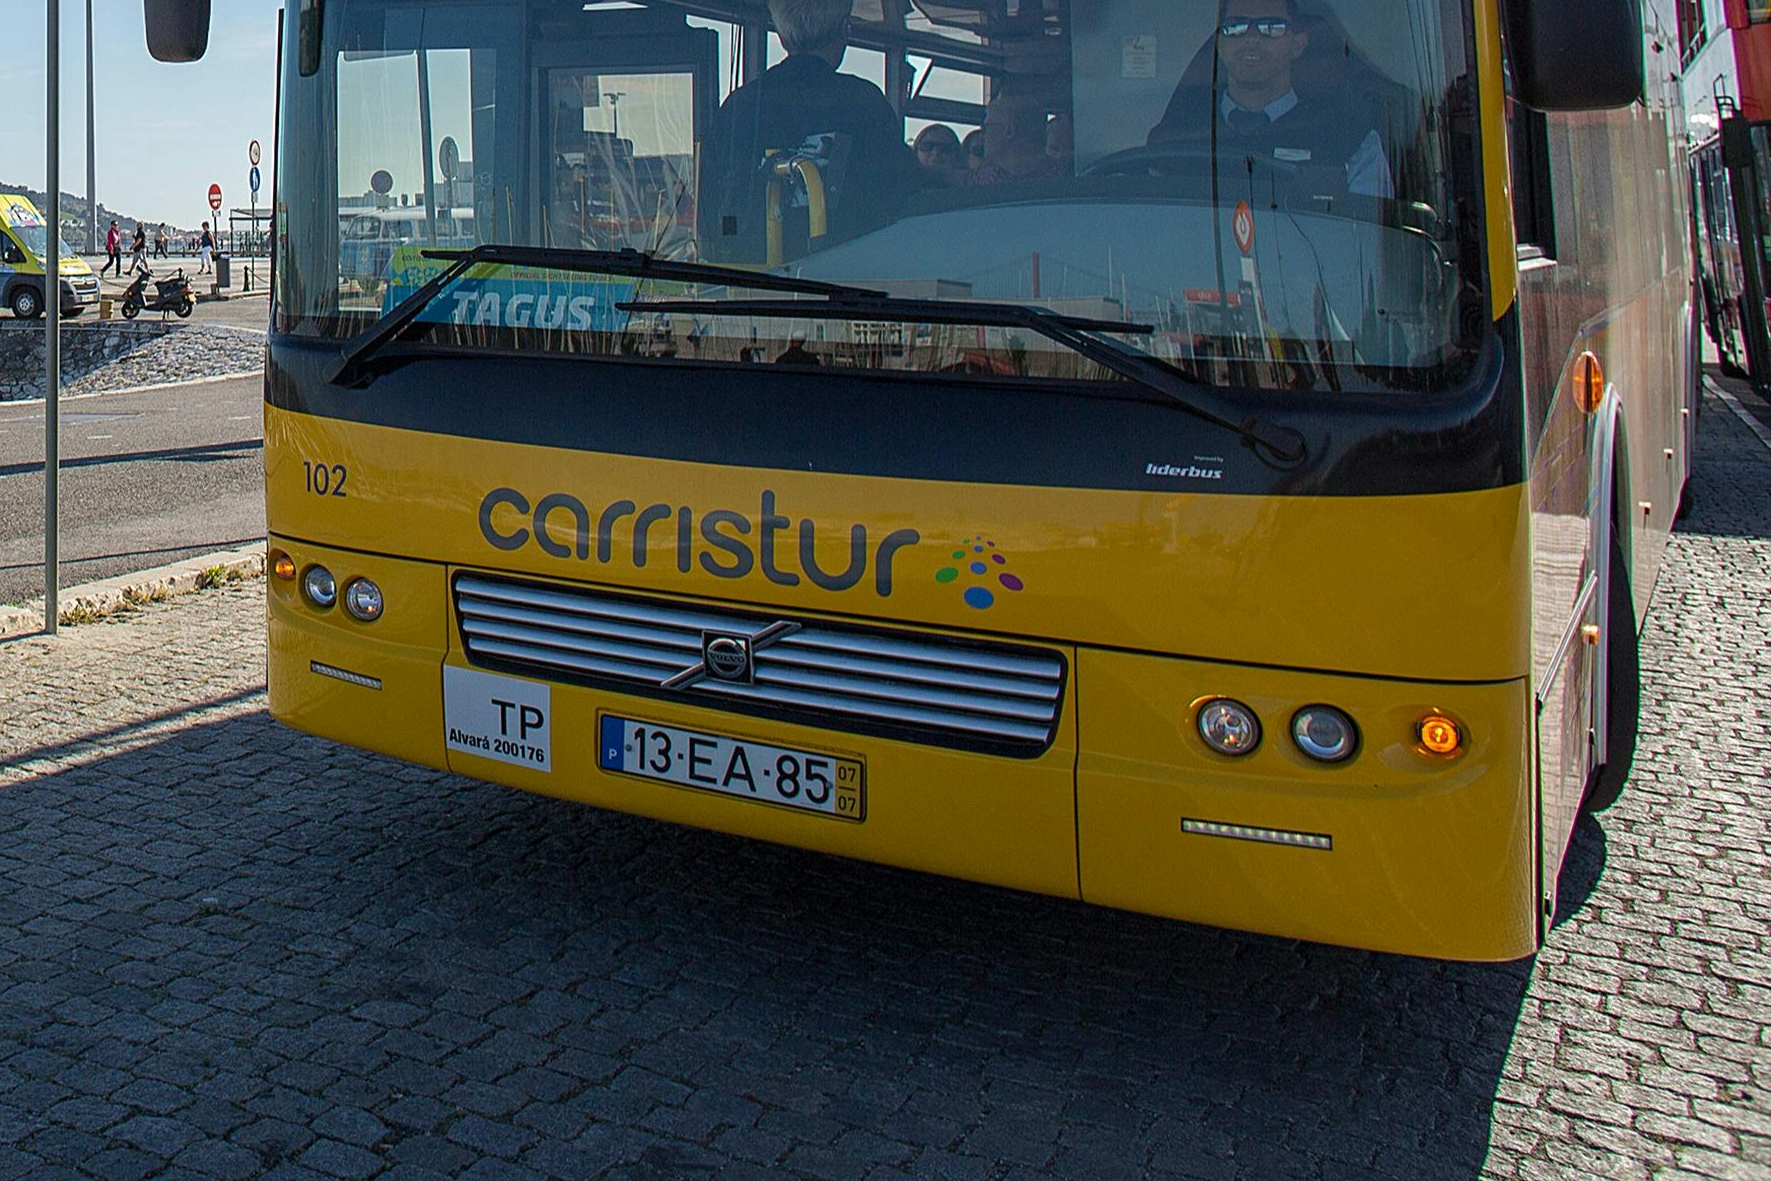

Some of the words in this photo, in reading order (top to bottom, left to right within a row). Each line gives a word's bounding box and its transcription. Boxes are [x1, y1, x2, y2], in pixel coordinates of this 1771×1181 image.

[453, 291, 595, 331] TAGUS
[303, 461, 347, 497] 102
[1146, 463, 1223, 479] liderbus
[479, 487, 920, 597] carristur
[491, 699, 544, 740] TP
[449, 728, 490, 750] Alvará
[494, 739, 545, 763] 200176
[608, 748, 617, 760] P
[838, 766, 856, 782] 07
[838, 795, 856, 812] 07
